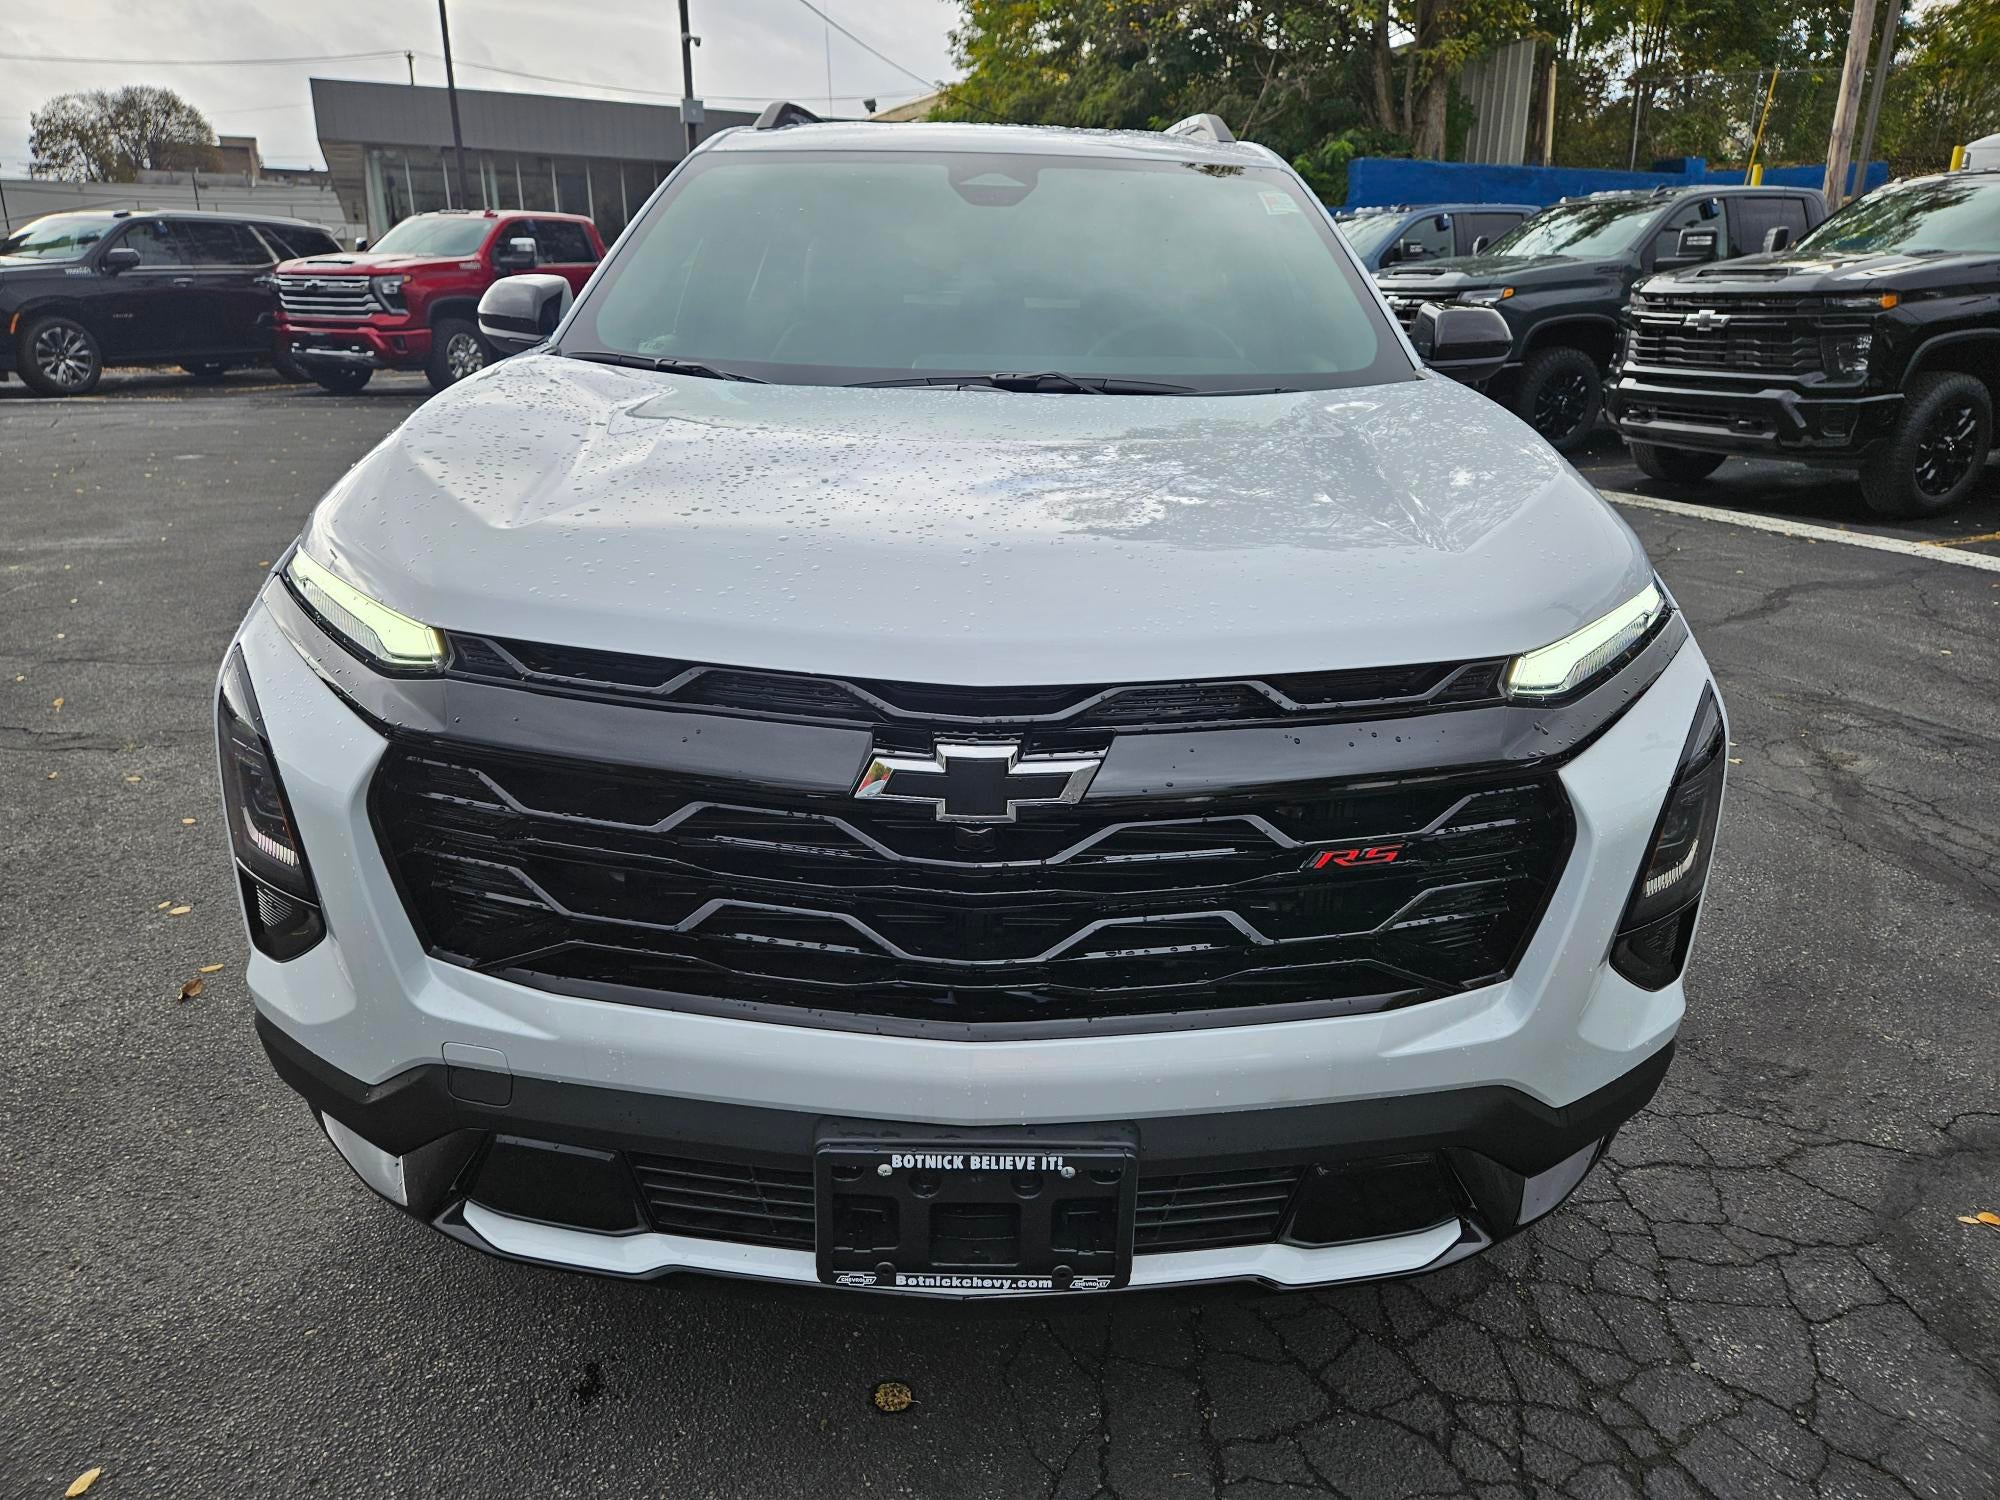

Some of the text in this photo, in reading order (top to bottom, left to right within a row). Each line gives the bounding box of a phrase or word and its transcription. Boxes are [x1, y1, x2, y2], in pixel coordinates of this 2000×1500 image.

[1306, 843, 1405, 869] RS
[891, 1154, 1063, 1171] BOTNICK BELIEVE IT!
[895, 1275, 1053, 1289] Botnickchevy.com
